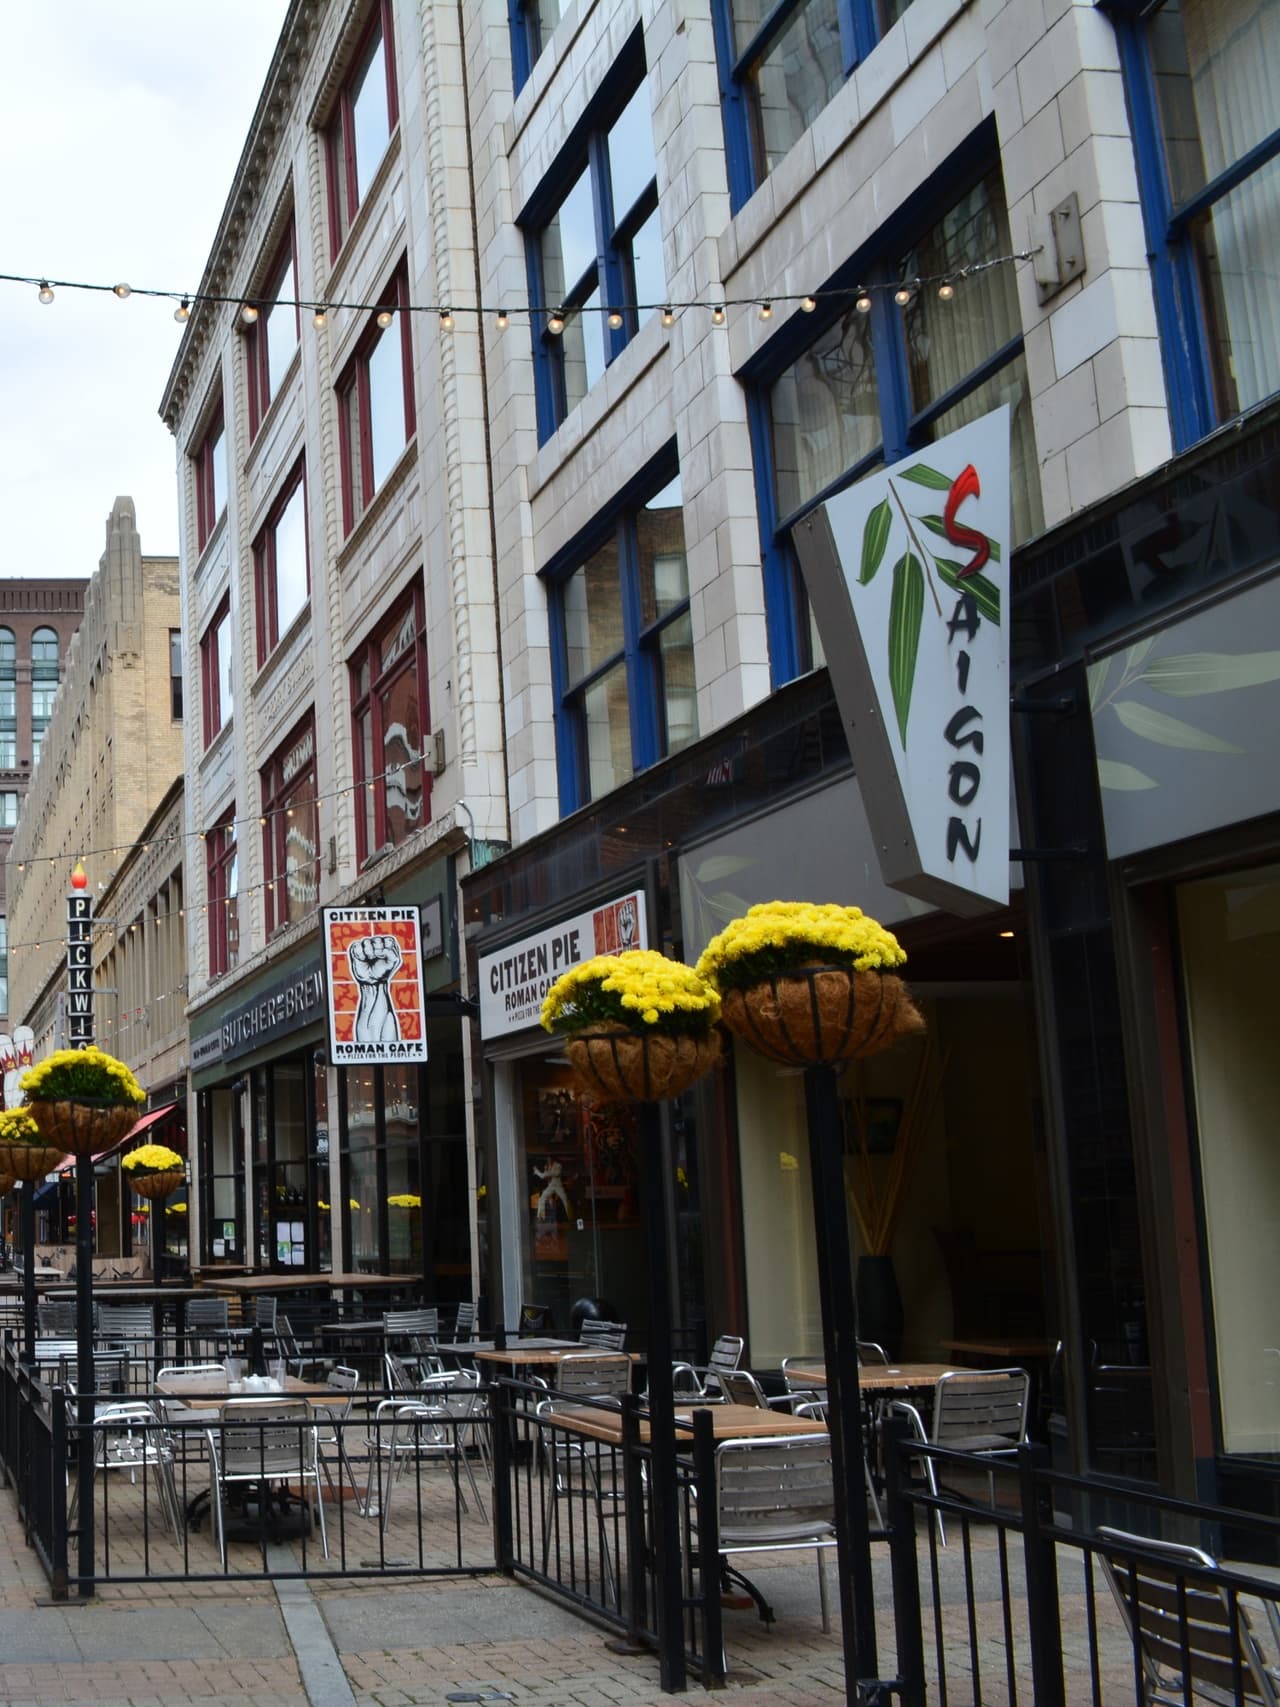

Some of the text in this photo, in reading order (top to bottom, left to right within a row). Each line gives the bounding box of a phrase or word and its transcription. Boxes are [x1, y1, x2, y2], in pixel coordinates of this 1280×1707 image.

[943, 462, 992, 866] SAIGON
[329, 910, 415, 922] CITIZEN PIE
[490, 929, 581, 995] CITIZEN PIE
[284, 969, 324, 1021] BREW
[505, 973, 563, 1011] ROMAN CA
[222, 997, 277, 1050] BUTCHER
[336, 1043, 423, 1054] ROMAN CAFE
